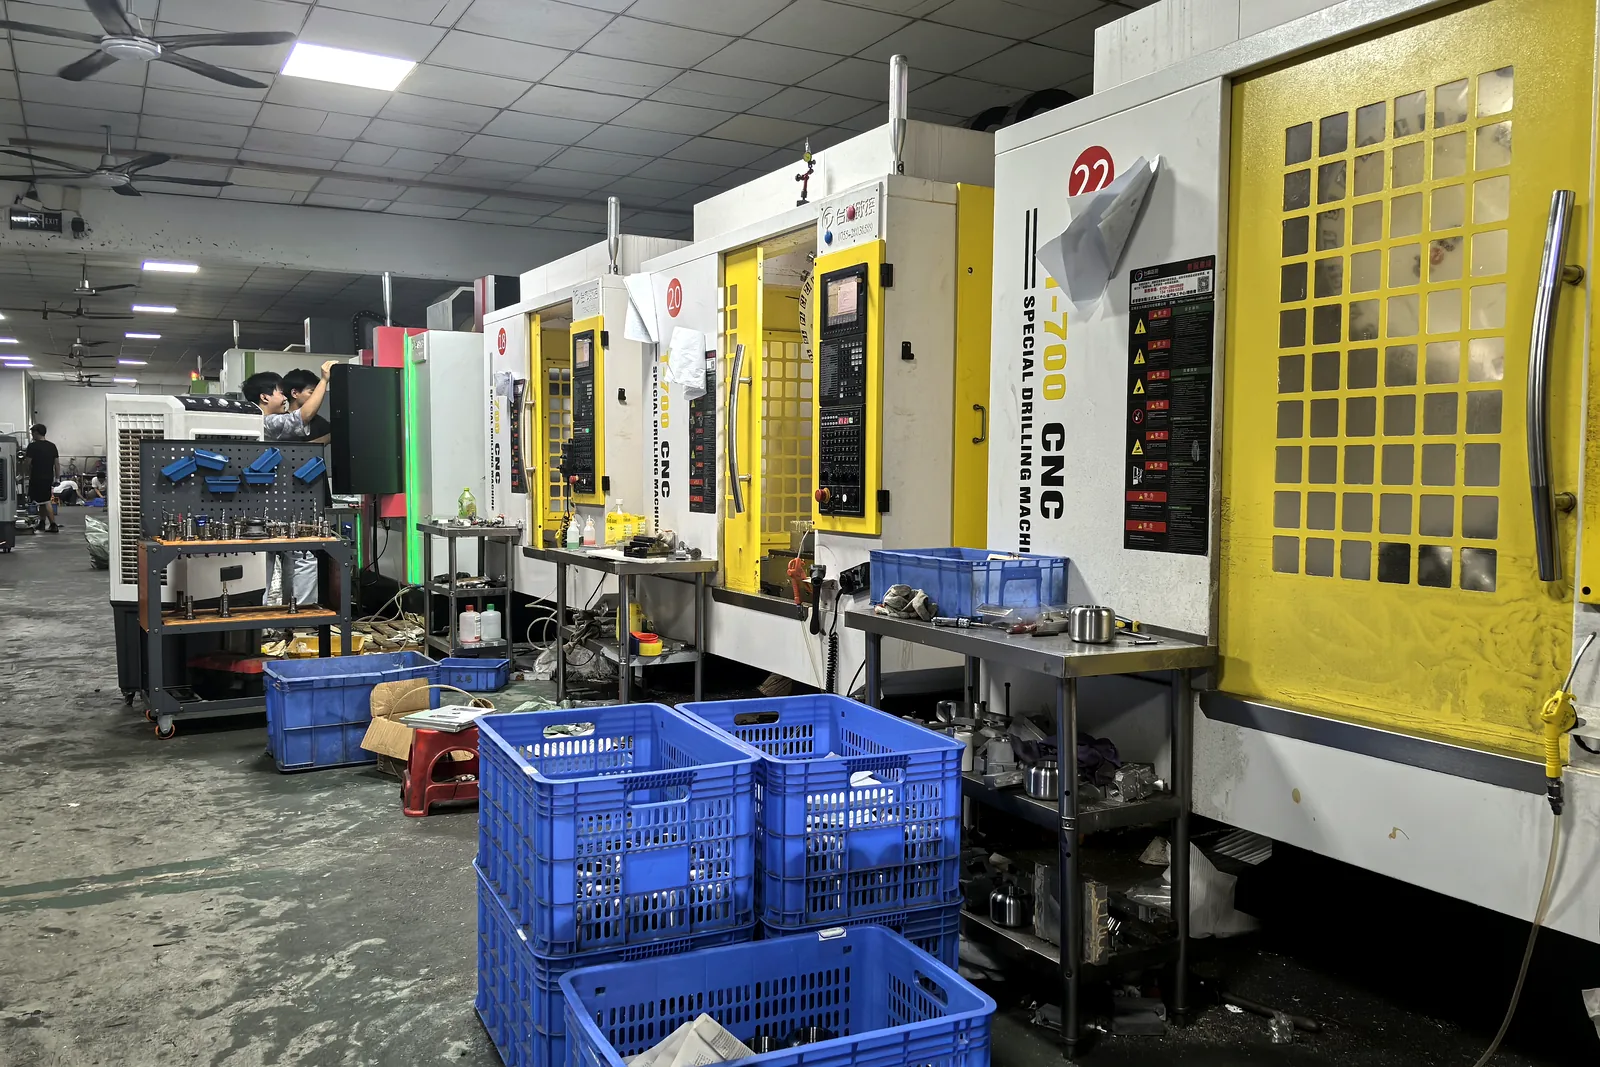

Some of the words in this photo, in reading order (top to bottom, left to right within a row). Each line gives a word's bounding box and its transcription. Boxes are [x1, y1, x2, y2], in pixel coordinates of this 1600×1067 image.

[1074, 158, 1109, 196] 22
[668, 285, 681, 310] 20
[498, 333, 506, 349] 18
[1022, 295, 1036, 383] SPECIAL
[1020, 387, 1033, 480] DRILLING
[660, 440, 671, 498] CNC
[1041, 422, 1066, 520] CNC
[1018, 486, 1031, 553] MACHI
